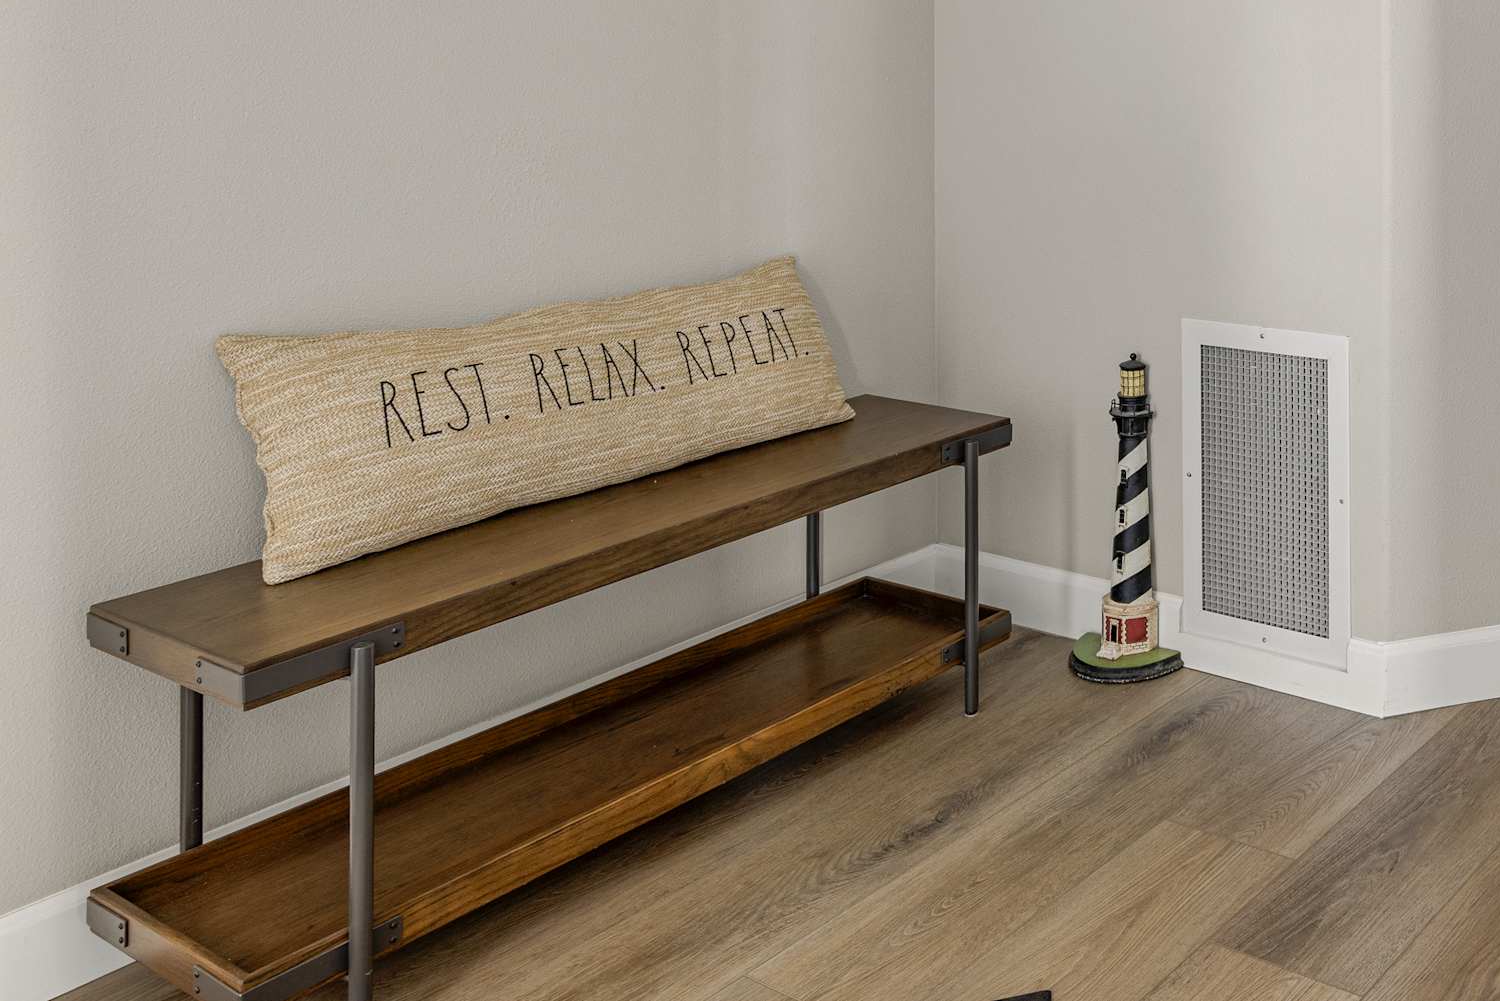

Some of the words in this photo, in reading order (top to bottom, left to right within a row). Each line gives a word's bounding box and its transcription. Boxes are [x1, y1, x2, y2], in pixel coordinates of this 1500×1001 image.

[379, 362, 511, 449] REST.
[529, 338, 666, 414] RELAX.
[675, 307, 810, 386] REPEAT.
